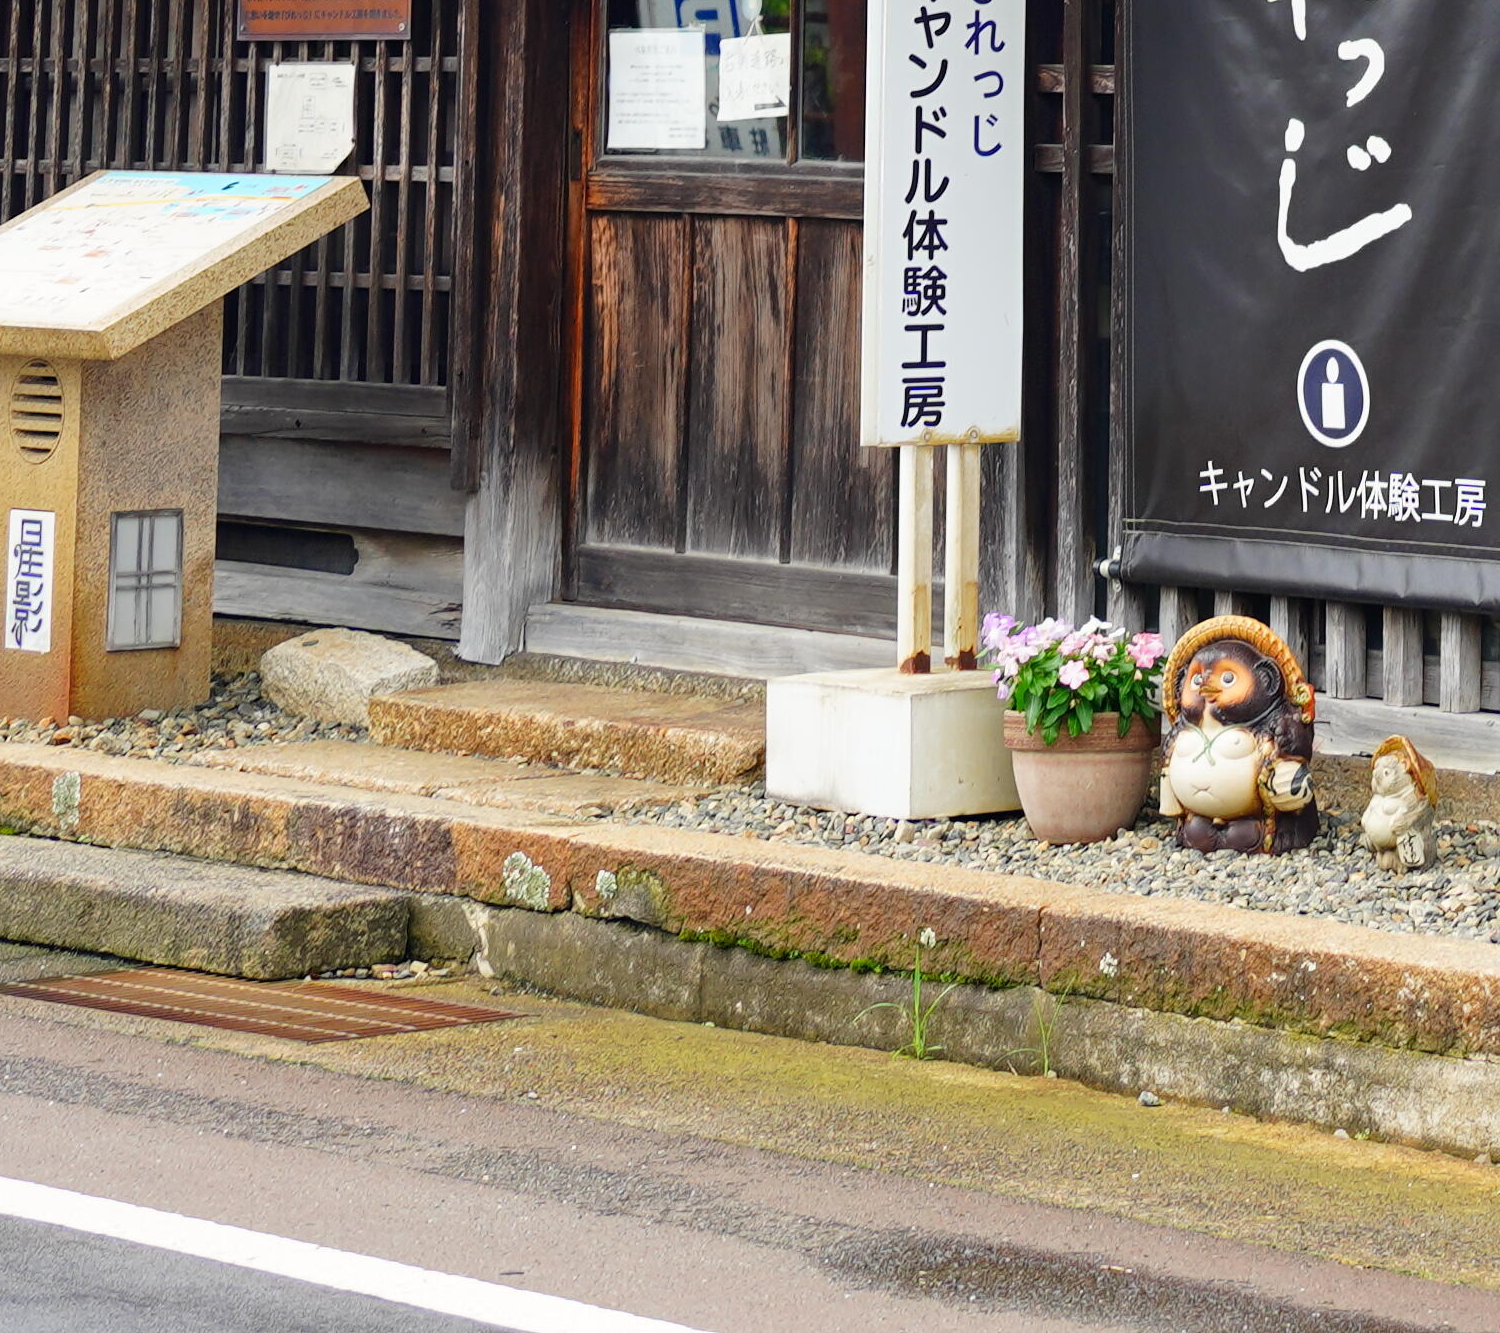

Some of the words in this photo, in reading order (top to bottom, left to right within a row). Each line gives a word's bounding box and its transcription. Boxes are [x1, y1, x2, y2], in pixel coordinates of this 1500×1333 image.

[1199, 460, 1487, 528] キャンドル体験工房
